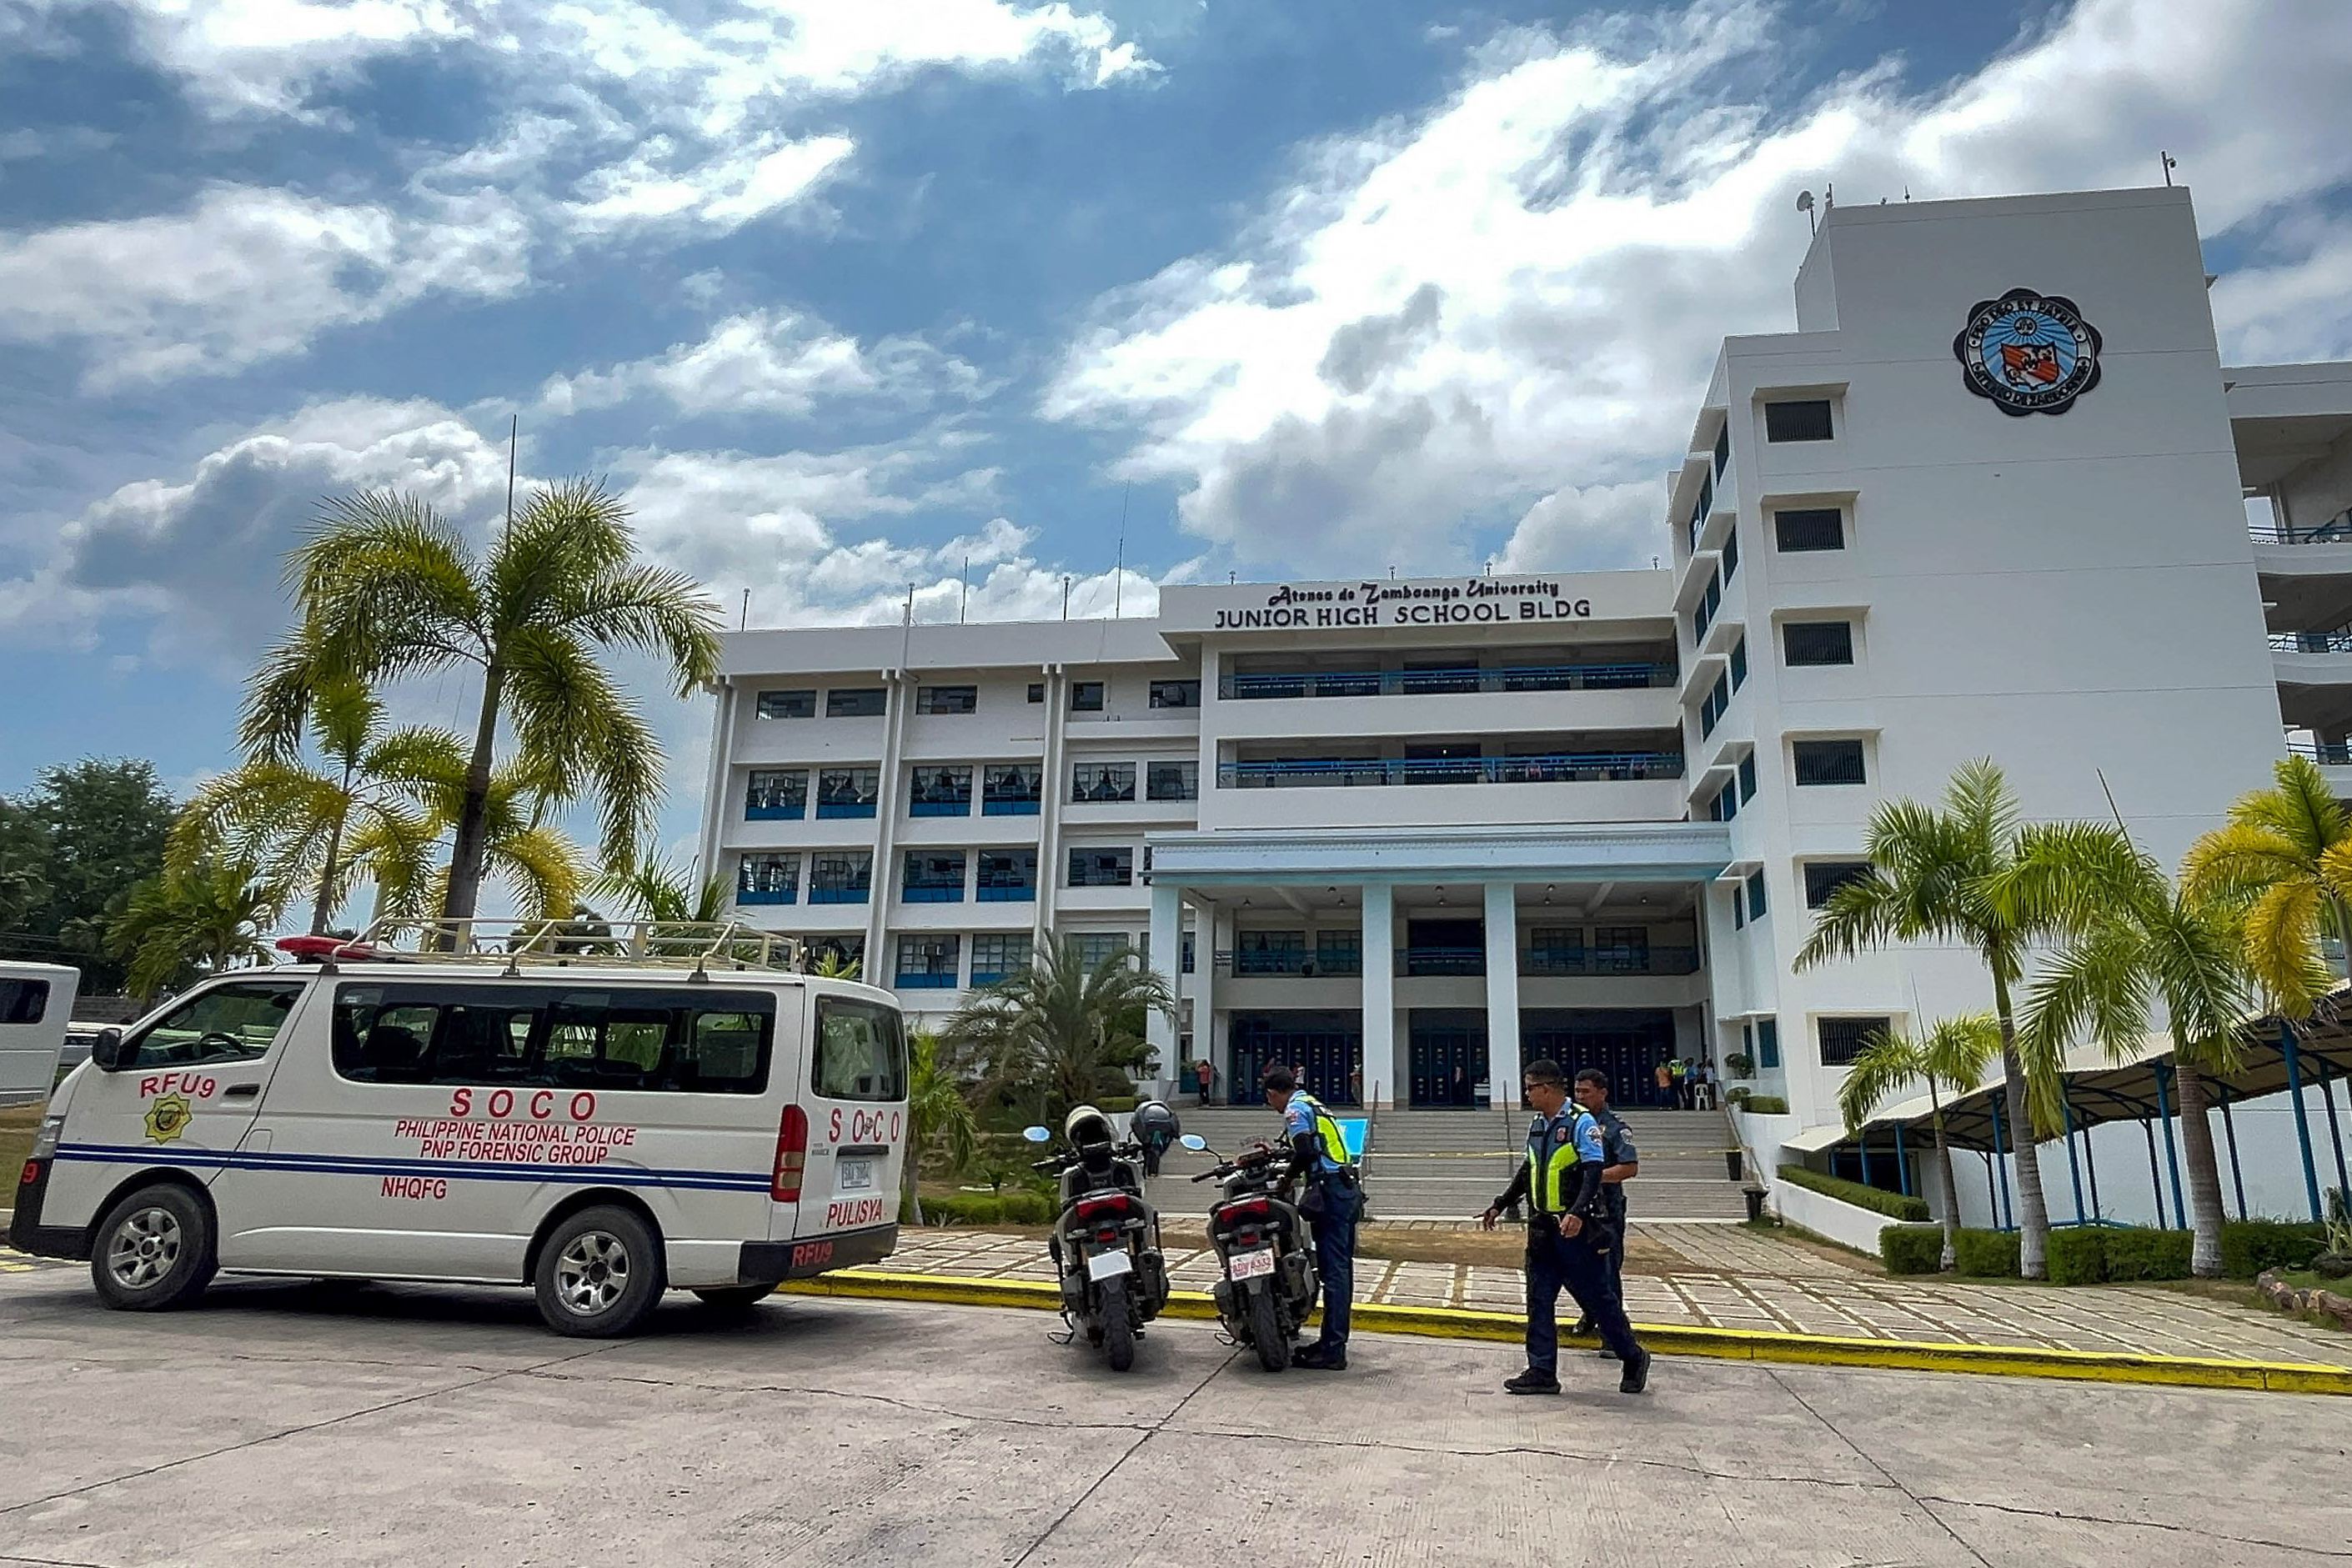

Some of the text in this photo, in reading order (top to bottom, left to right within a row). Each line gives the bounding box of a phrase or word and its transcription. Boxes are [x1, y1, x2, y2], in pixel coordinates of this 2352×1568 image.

[2037, 300, 2079, 333] PATRIA
[1268, 579, 1559, 606] Ateneo de Zamboanga University
[1215, 599, 1590, 629] JUNIOR HIGH SCHOOL BLDG
[140, 1072, 216, 1099] RFU9
[449, 1087, 596, 1122] SOCO
[394, 1120, 637, 1145] PHILIPPINE NATIONAL POLICE
[829, 1107, 900, 1143] SOCO
[419, 1140, 608, 1165] PNP FORENSIC GROUP
[381, 1176, 447, 1200] NHQFG
[825, 1198, 883, 1229] PULISYA
[791, 1240, 833, 1268] RFU9
